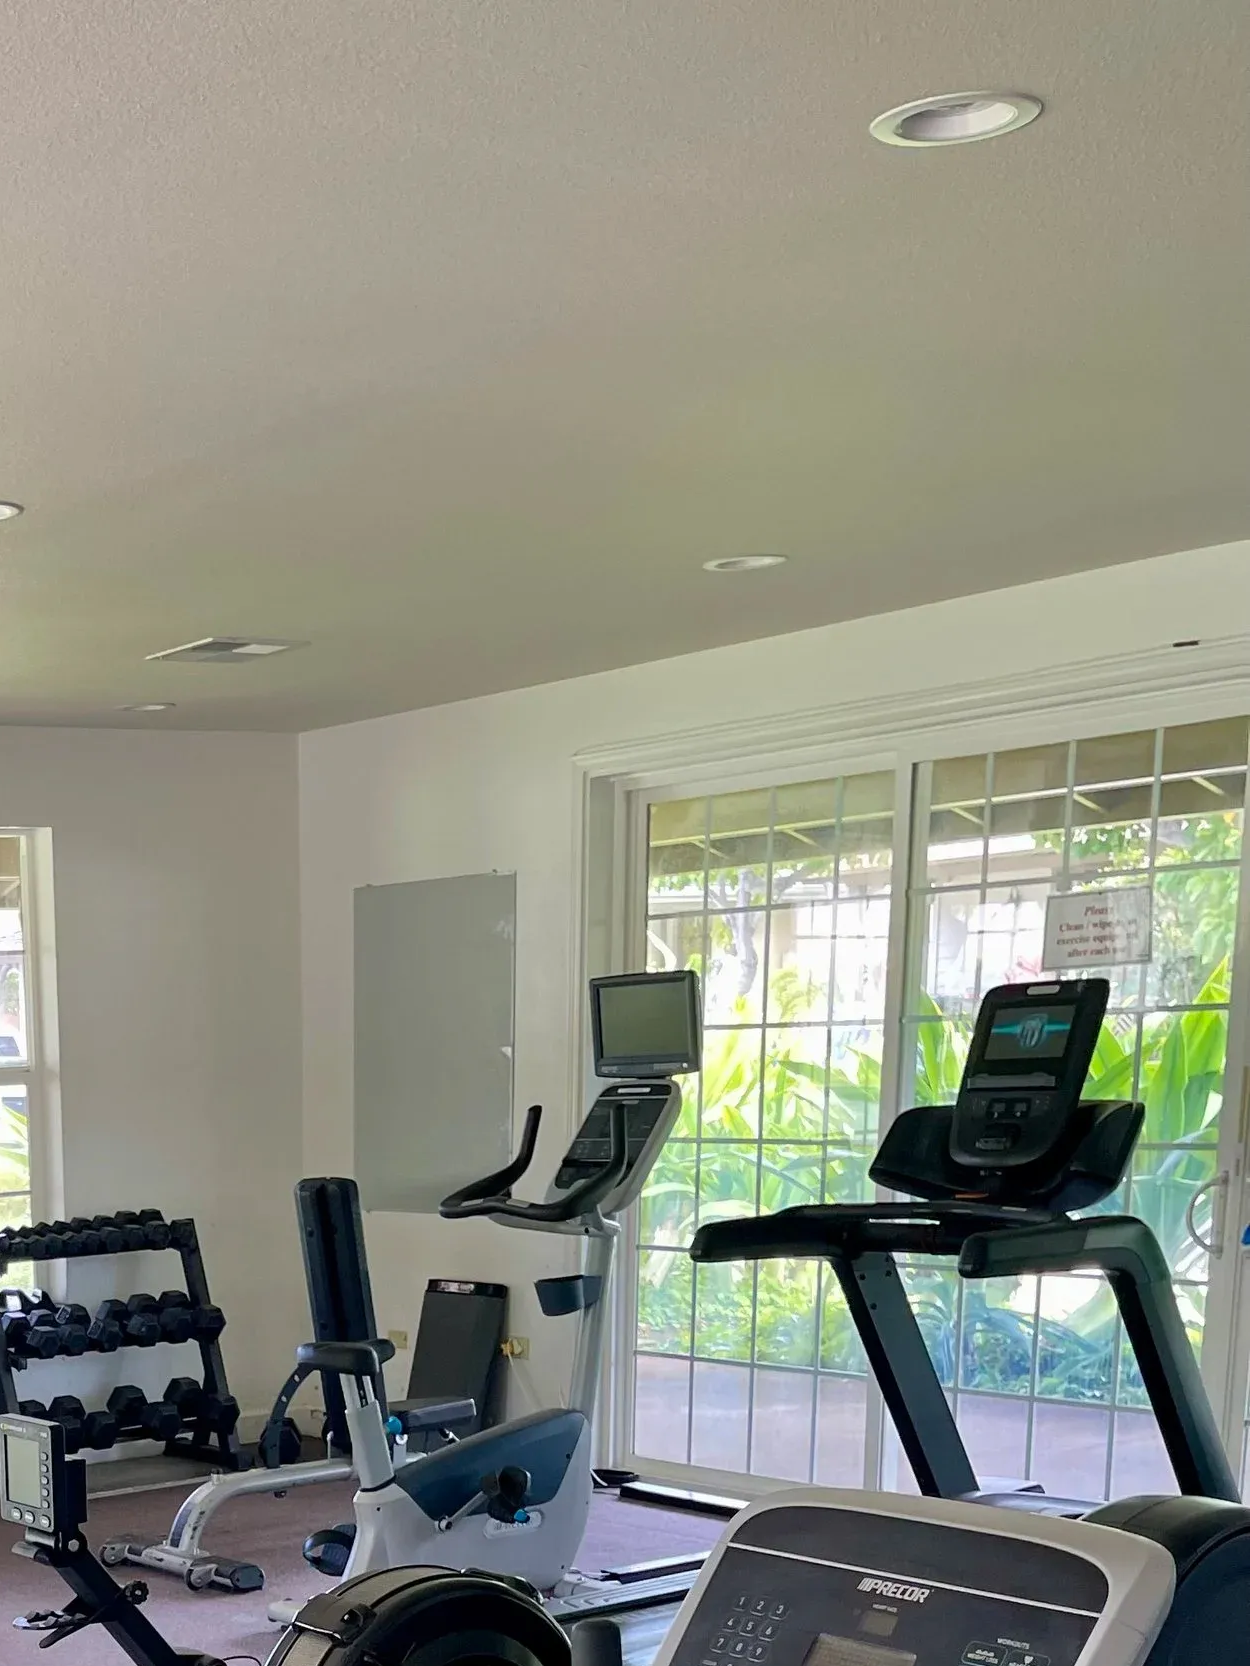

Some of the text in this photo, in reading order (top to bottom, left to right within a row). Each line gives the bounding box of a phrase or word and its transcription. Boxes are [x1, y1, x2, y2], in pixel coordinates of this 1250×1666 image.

[866, 1578, 930, 1603] PRECOR
[739, 1597, 784, 1614] 1 2 3
[727, 1618, 772, 1635] 4 5 6
[717, 1638, 762, 1656] 7 8 9
